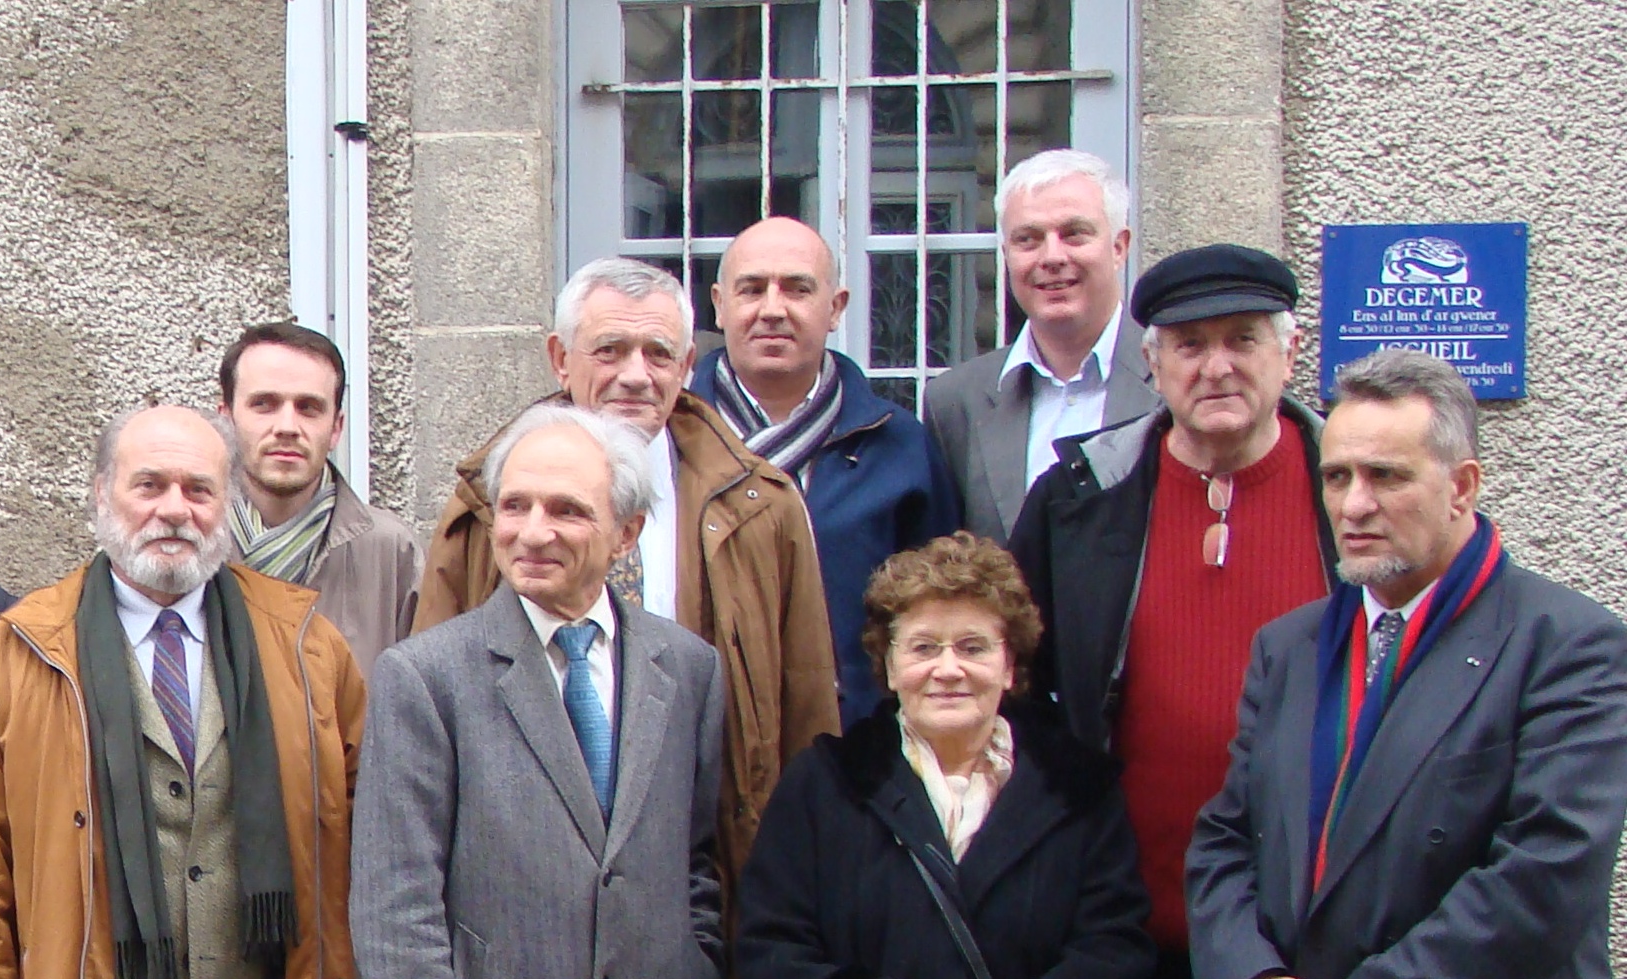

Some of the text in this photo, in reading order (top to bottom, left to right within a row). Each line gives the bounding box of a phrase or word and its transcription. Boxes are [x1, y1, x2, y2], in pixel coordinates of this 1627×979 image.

[1365, 286, 1483, 307] DEGEMER
[1379, 309, 1393, 322] al
[1450, 310, 1498, 324] gwener
[1457, 361, 1513, 375] vendredi
